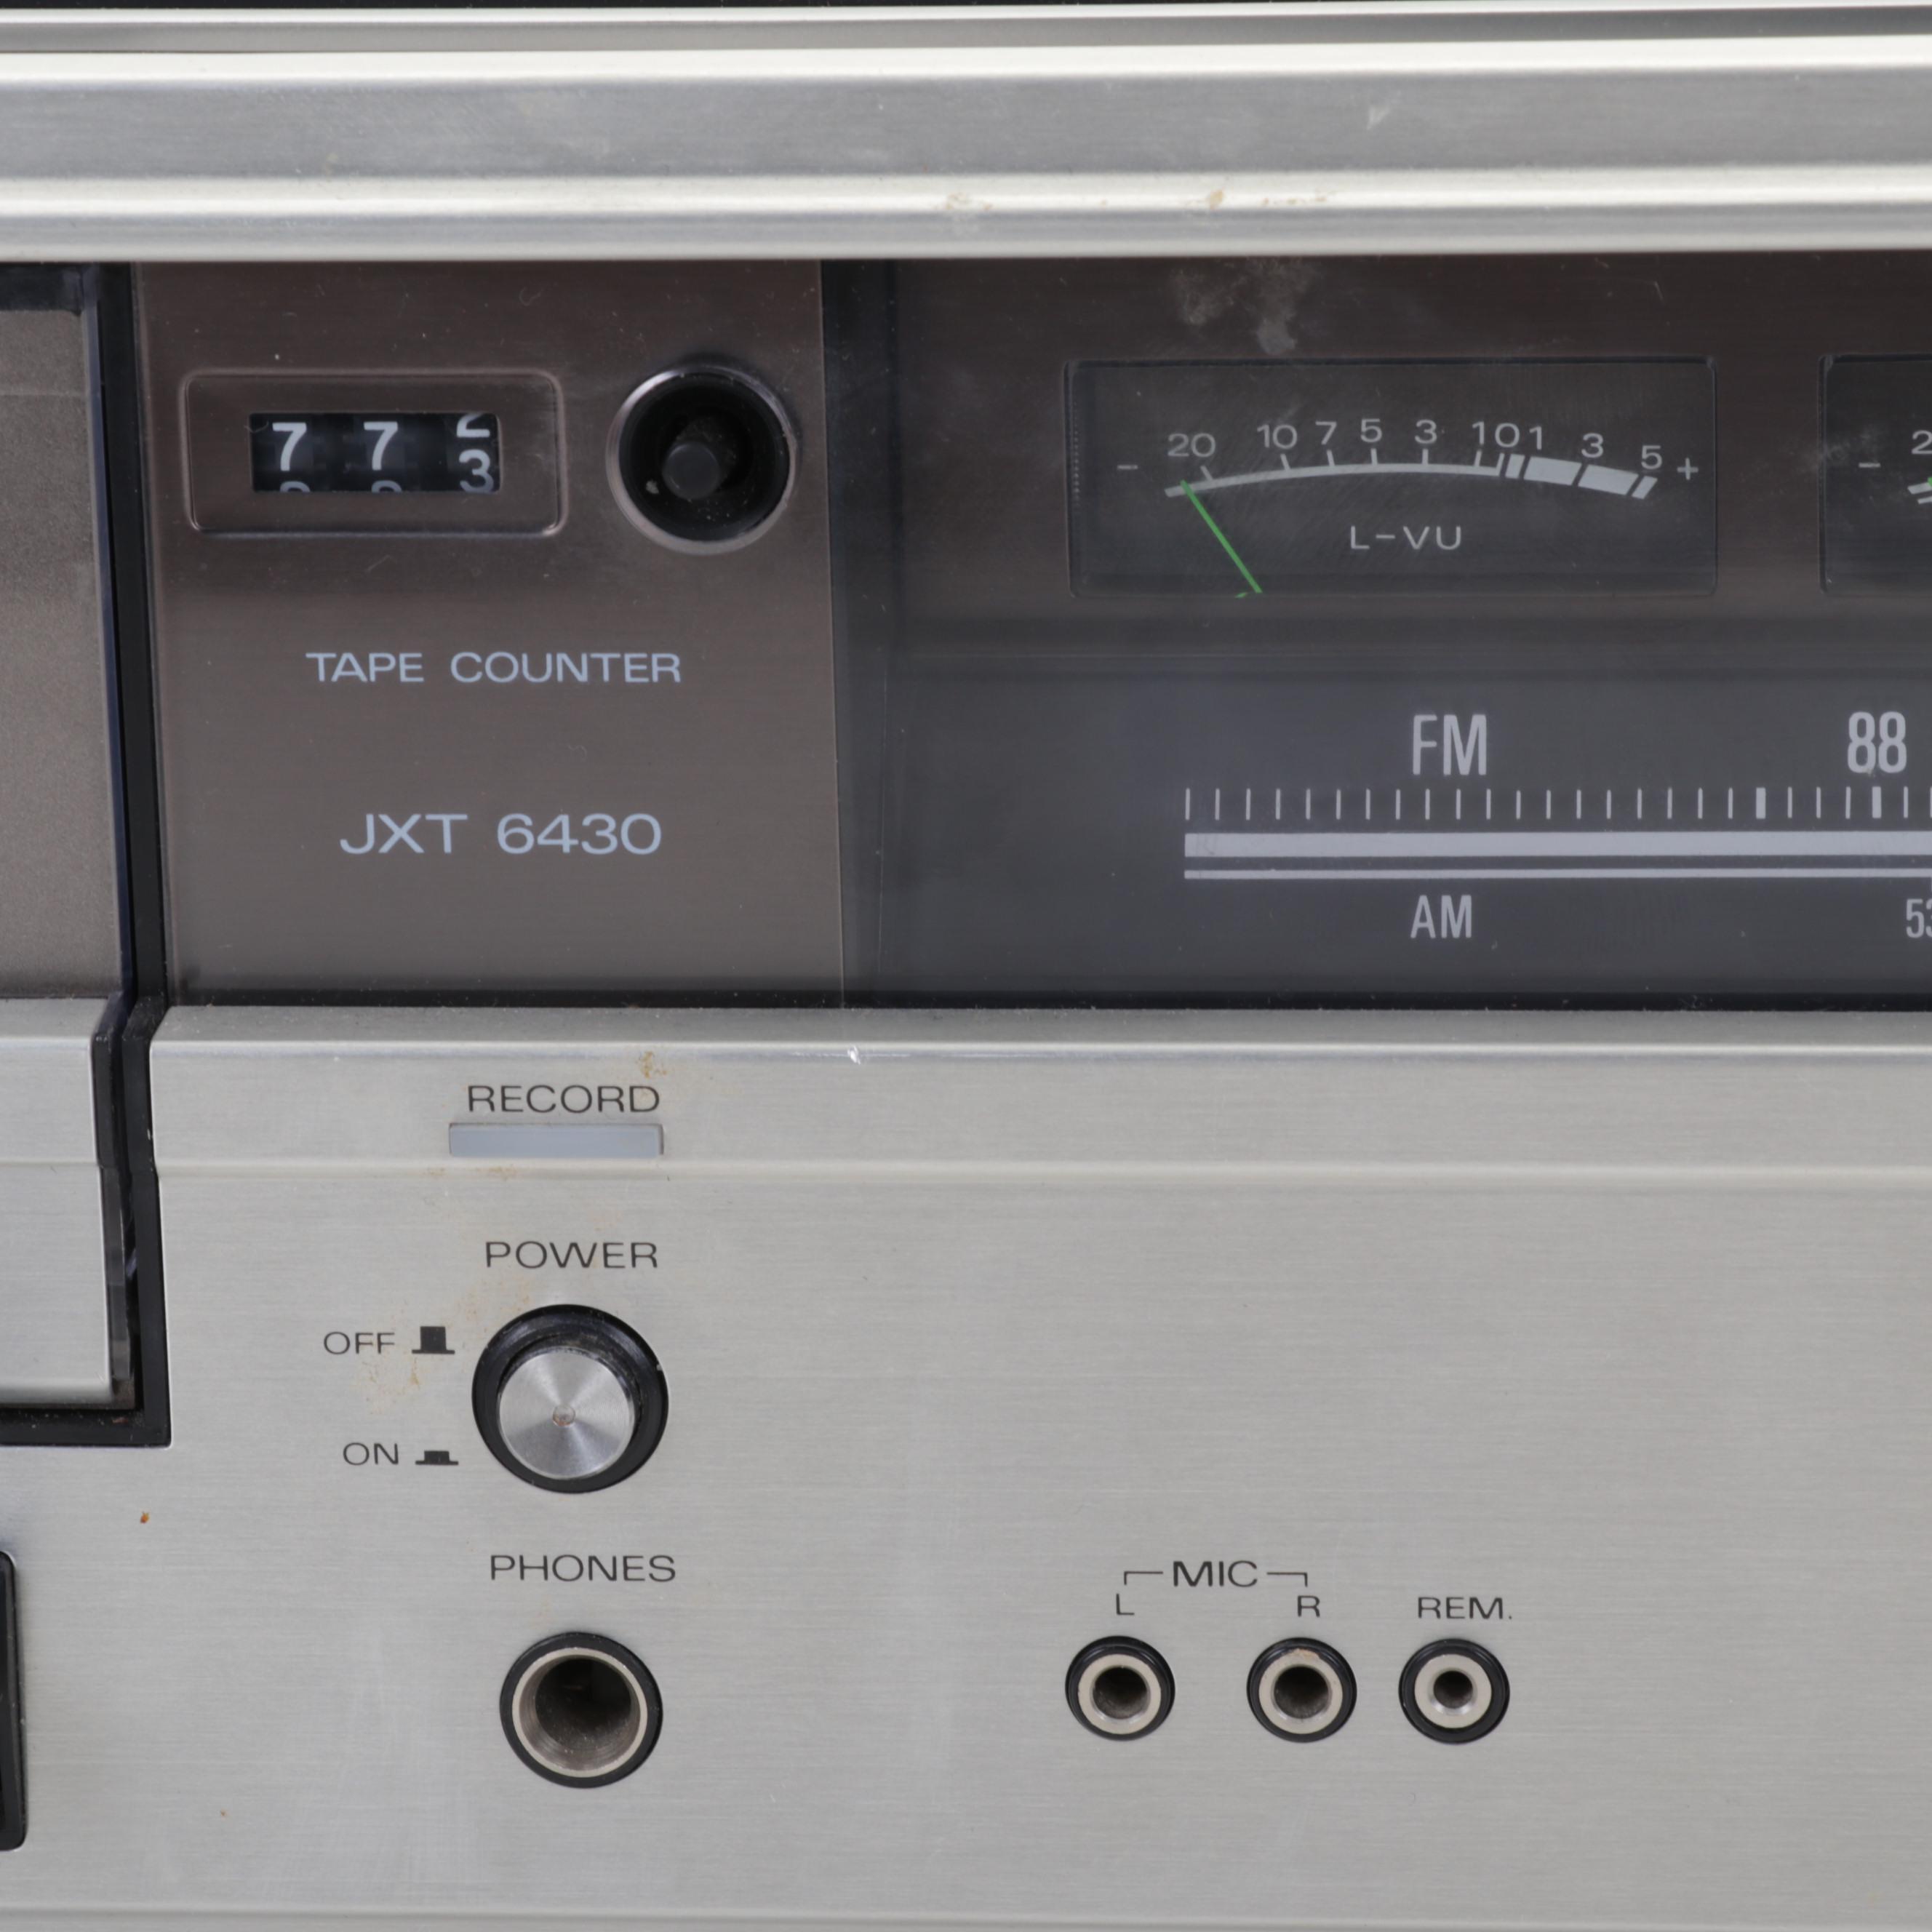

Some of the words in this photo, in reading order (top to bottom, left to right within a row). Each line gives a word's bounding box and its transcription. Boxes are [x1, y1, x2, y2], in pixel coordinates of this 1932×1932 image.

[1167, 432, 1216, 458] 20
[1256, 424, 1298, 450] 10
[1314, 420, 1338, 445] 7
[1360, 418, 1383, 443] 5
[1414, 418, 1438, 444] 3
[1581, 432, 1605, 458] 3
[1640, 444, 1663, 471] 5
[306, 652, 424, 683] TAPE
[450, 651, 682, 684] COUNTER
[1412, 714, 1488, 776] FM
[1847, 711, 1907, 774] 88
[339, 813, 468, 855] JXT
[496, 813, 663, 855] 6430
[1410, 894, 1473, 939] AM
[467, 1084, 660, 1114] RECORD
[485, 1240, 658, 1269] POWER
[322, 1330, 395, 1356] OFF
[342, 1442, 400, 1466] ON
[490, 1554, 676, 1583] PHONES
[1172, 1560, 1258, 1588] MIC
[1115, 1592, 1135, 1616] L
[1296, 1594, 1321, 1618] R
[1417, 1596, 1512, 1620] REM.
